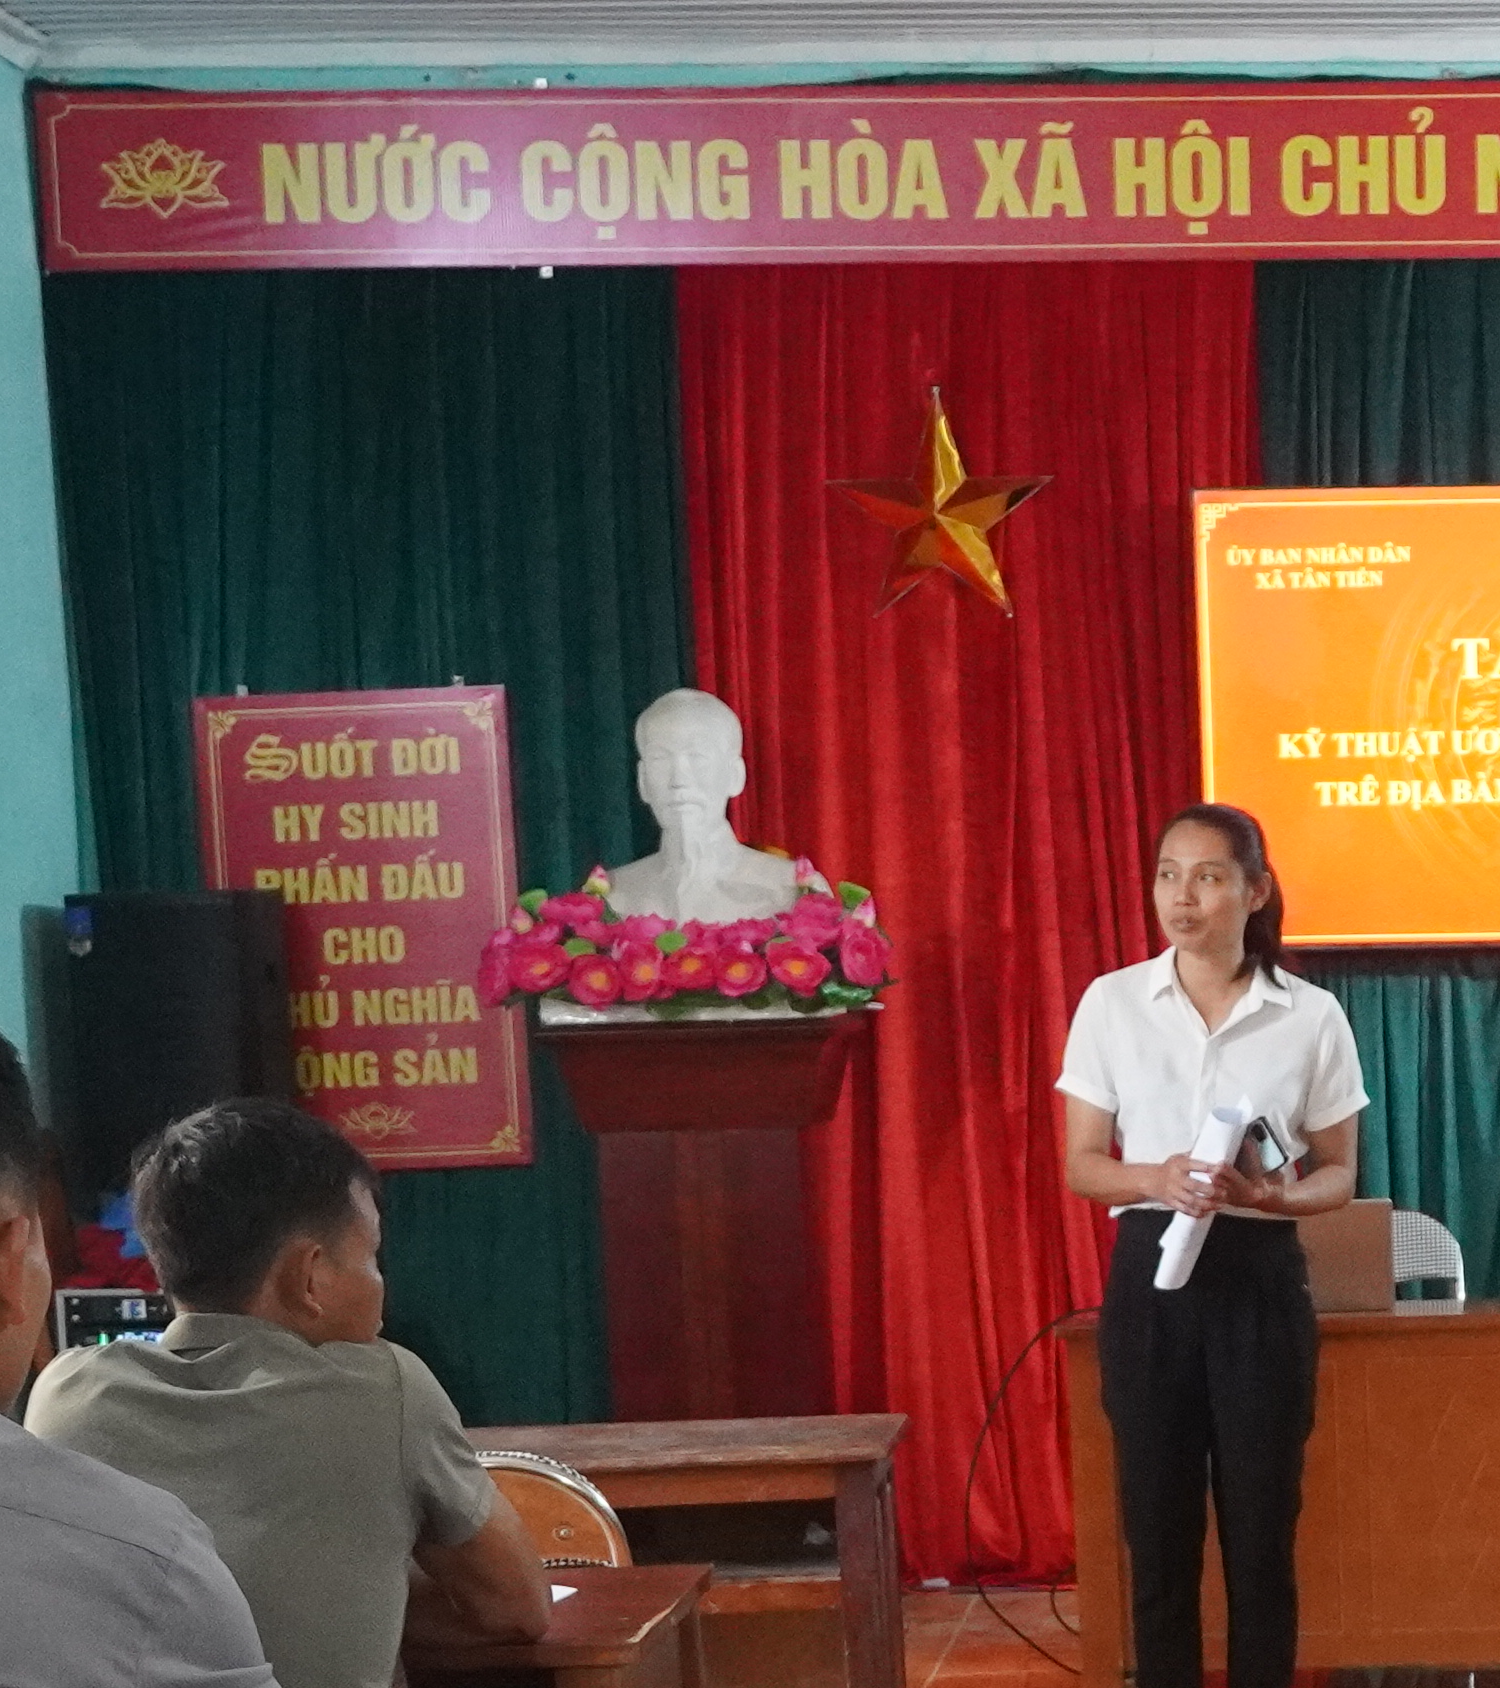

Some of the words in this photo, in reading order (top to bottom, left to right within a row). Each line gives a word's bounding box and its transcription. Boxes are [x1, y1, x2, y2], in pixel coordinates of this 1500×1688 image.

[262, 124, 491, 224] NƯỚC
[520, 122, 751, 240] CỘNG
[779, 118, 949, 220] HÒA
[974, 121, 1088, 219] XÃ
[1113, 118, 1252, 236] HỘI
[1281, 106, 1446, 217] CHỦ
[1259, 548, 1302, 566] BAN
[1305, 542, 1364, 565] NHÂN
[1367, 541, 1411, 564] DÂN
[1255, 568, 1286, 590] XÃ
[1288, 566, 1331, 589] TÂN
[392, 727, 461, 776] ĐỜI
[1278, 727, 1326, 759] KỸ
[1330, 727, 1445, 763] THUẬT
[1314, 774, 1381, 806] TRÊ
[1386, 780, 1447, 811] ĐỊA
[273, 803, 325, 843] HY
[339, 800, 440, 841] SINH
[380, 849, 465, 900] ĐẤU
[323, 925, 406, 965] CHO
[291, 974, 340, 1029] HỦ
[352, 978, 482, 1026] NGHĨA
[296, 1045, 381, 1097] ỘNG
[393, 1031, 479, 1087] SẢN
